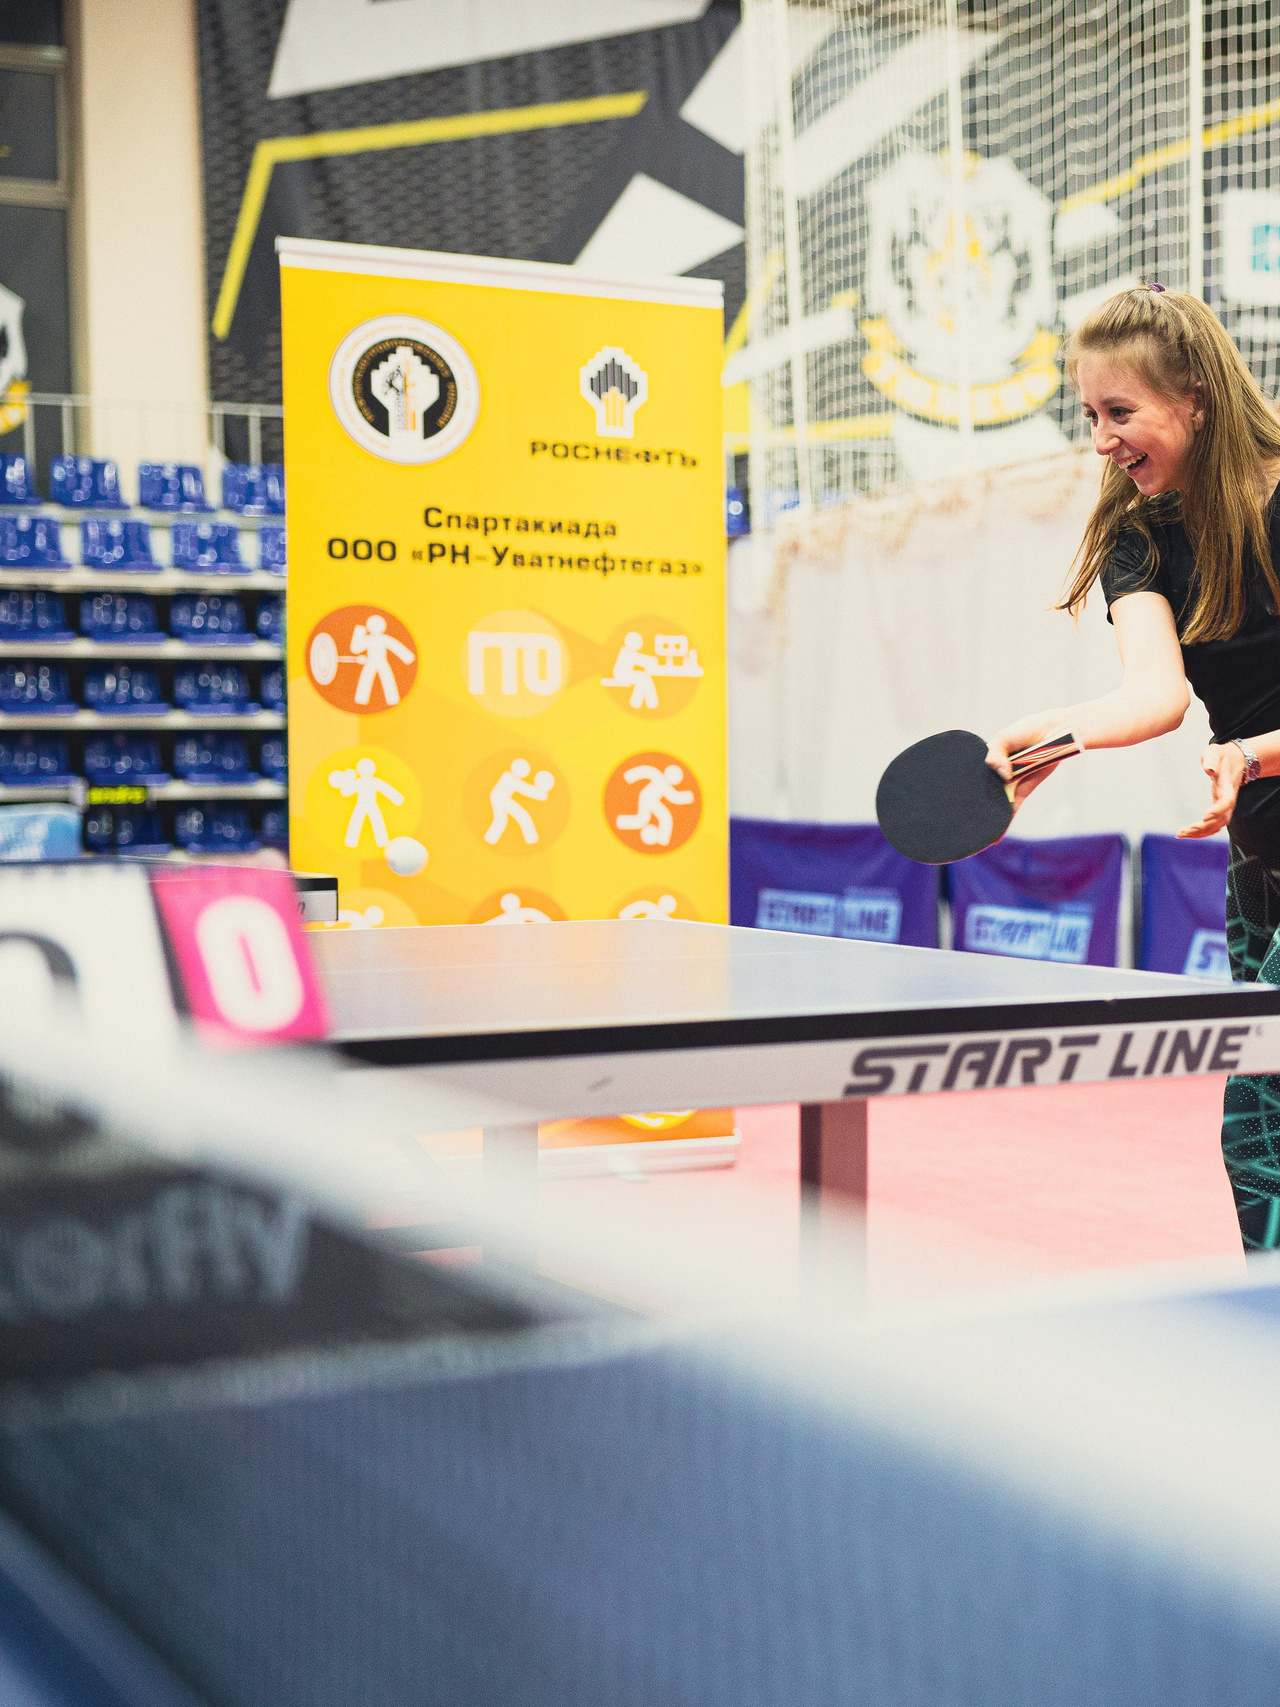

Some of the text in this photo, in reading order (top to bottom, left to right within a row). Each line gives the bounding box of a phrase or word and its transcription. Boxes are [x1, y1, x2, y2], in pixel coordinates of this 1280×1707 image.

[530, 440, 698, 469] РОСНЕФТЬ
[423, 507, 618, 538] Спартакиада
[327, 538, 397, 562] ООО
[468, 631, 563, 696] ГТО
[842, 1025, 1252, 1099] START LINE
